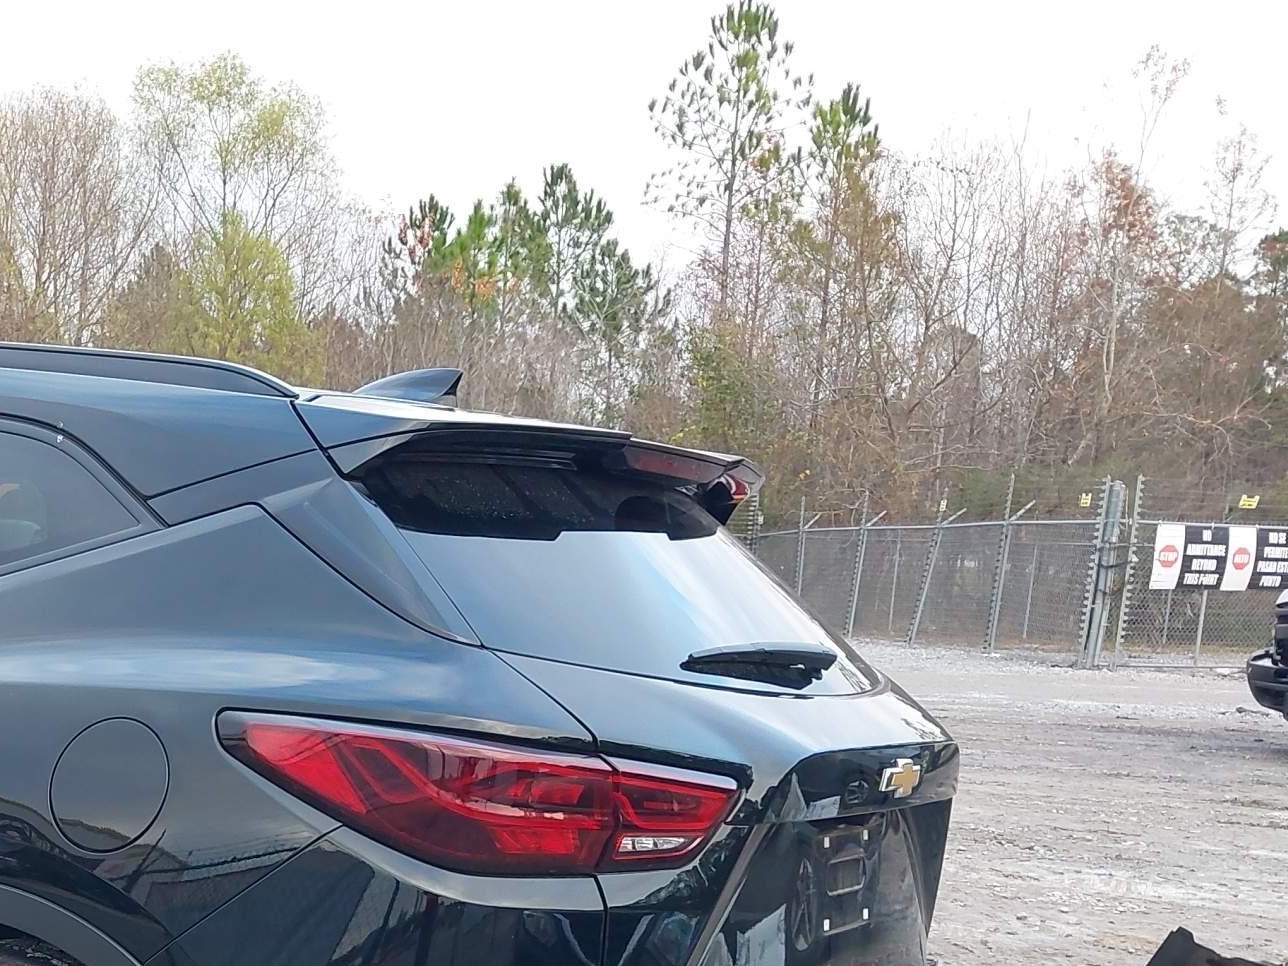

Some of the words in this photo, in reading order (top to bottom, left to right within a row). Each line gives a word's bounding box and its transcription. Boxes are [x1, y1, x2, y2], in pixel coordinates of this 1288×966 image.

[1202, 529, 1212, 541] NO
[1268, 532, 1279, 544] NO
[1278, 532, 1287, 544] SE
[1186, 543, 1227, 556] ADMITTANCE
[1159, 551, 1178, 562] STOP
[1191, 558, 1218, 571] BEYOND
[1256, 560, 1277, 573] PASAR
[1183, 572, 1200, 585] THIS
[1198, 573, 1220, 586] POINT
[1258, 575, 1282, 587] PUNTO
